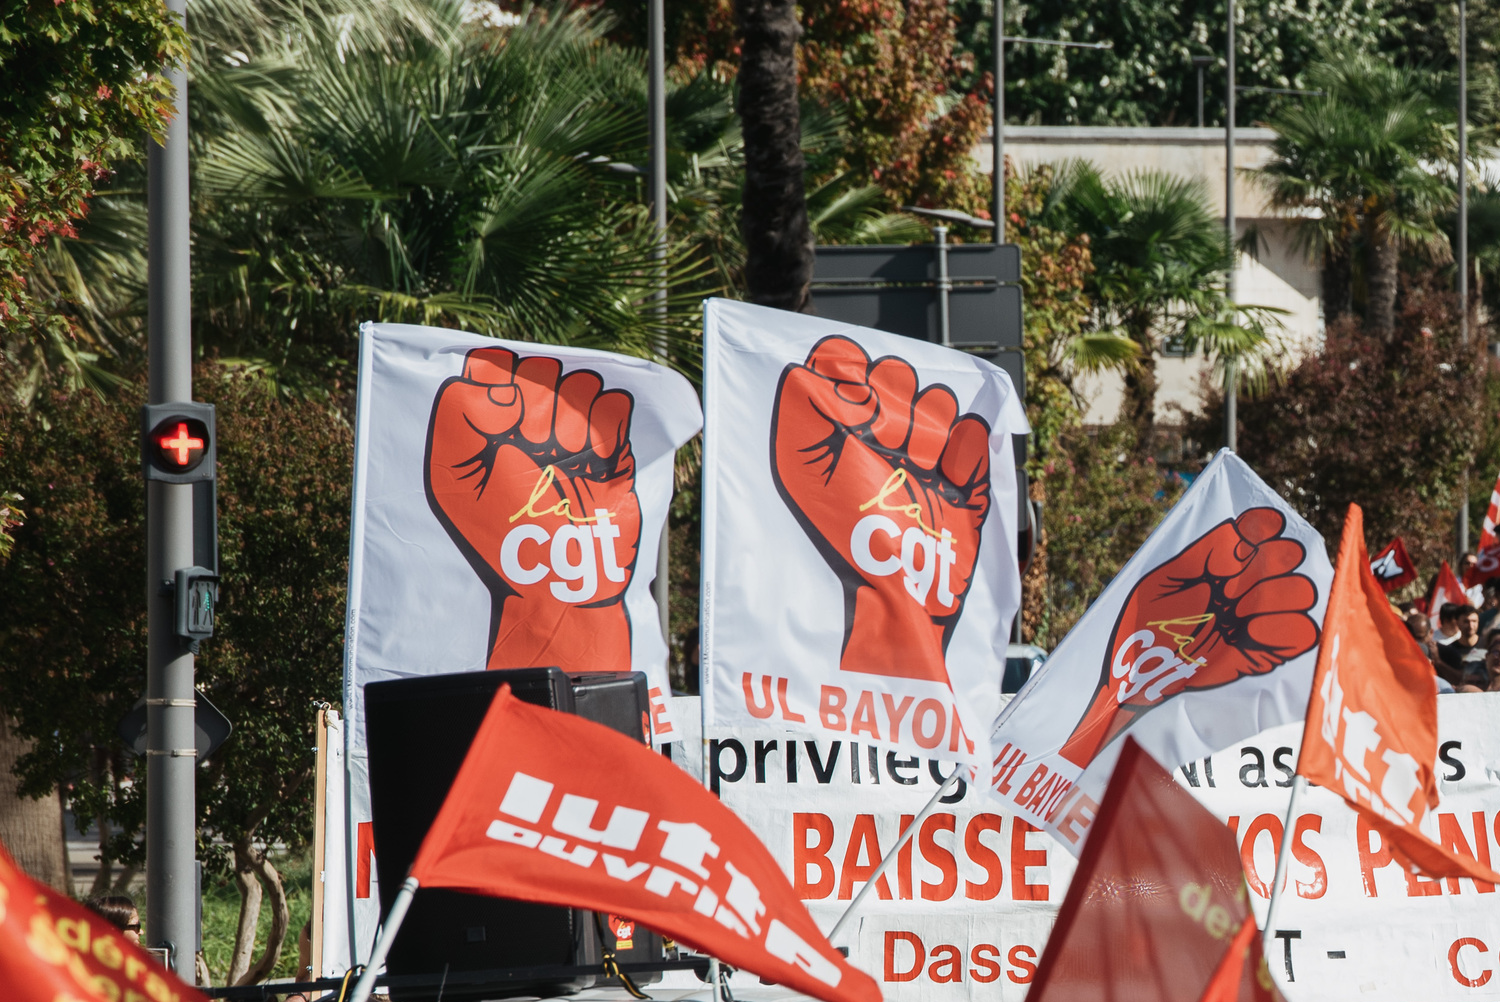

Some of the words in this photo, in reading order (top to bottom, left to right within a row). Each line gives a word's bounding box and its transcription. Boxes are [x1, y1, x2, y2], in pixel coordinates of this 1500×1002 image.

[509, 464, 616, 523] la
[859, 467, 957, 544] la
[500, 508, 625, 603] cgt
[850, 514, 956, 608] cgt
[1112, 629, 1207, 704] cgt
[742, 671, 806, 724] UL
[818, 683, 975, 756] BAYON
[884, 930, 1038, 985] Dass
